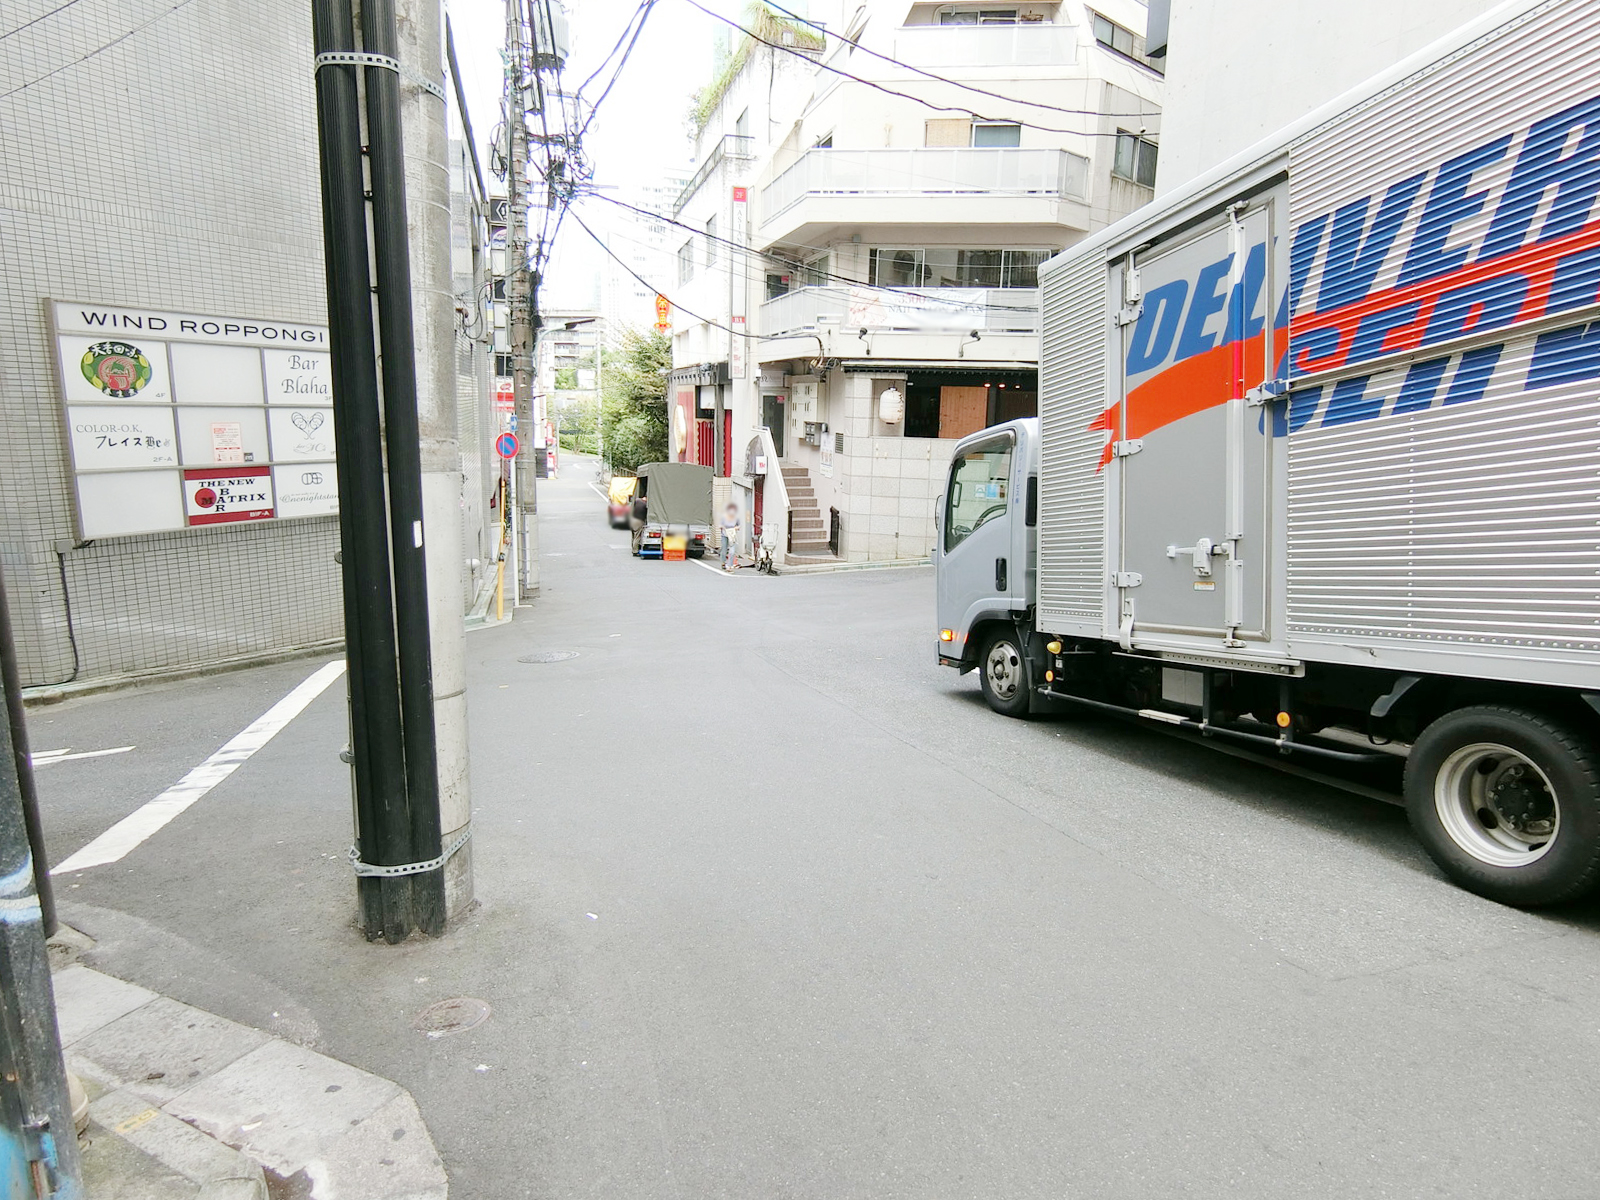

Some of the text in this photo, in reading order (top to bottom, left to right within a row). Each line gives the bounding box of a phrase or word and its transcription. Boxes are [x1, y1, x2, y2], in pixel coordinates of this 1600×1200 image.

[81, 311, 323, 343] WIND ROPPONGI
[288, 354, 319, 370] Bar
[281, 375, 328, 394] Blaha
[199, 478, 256, 488] THE NEW
